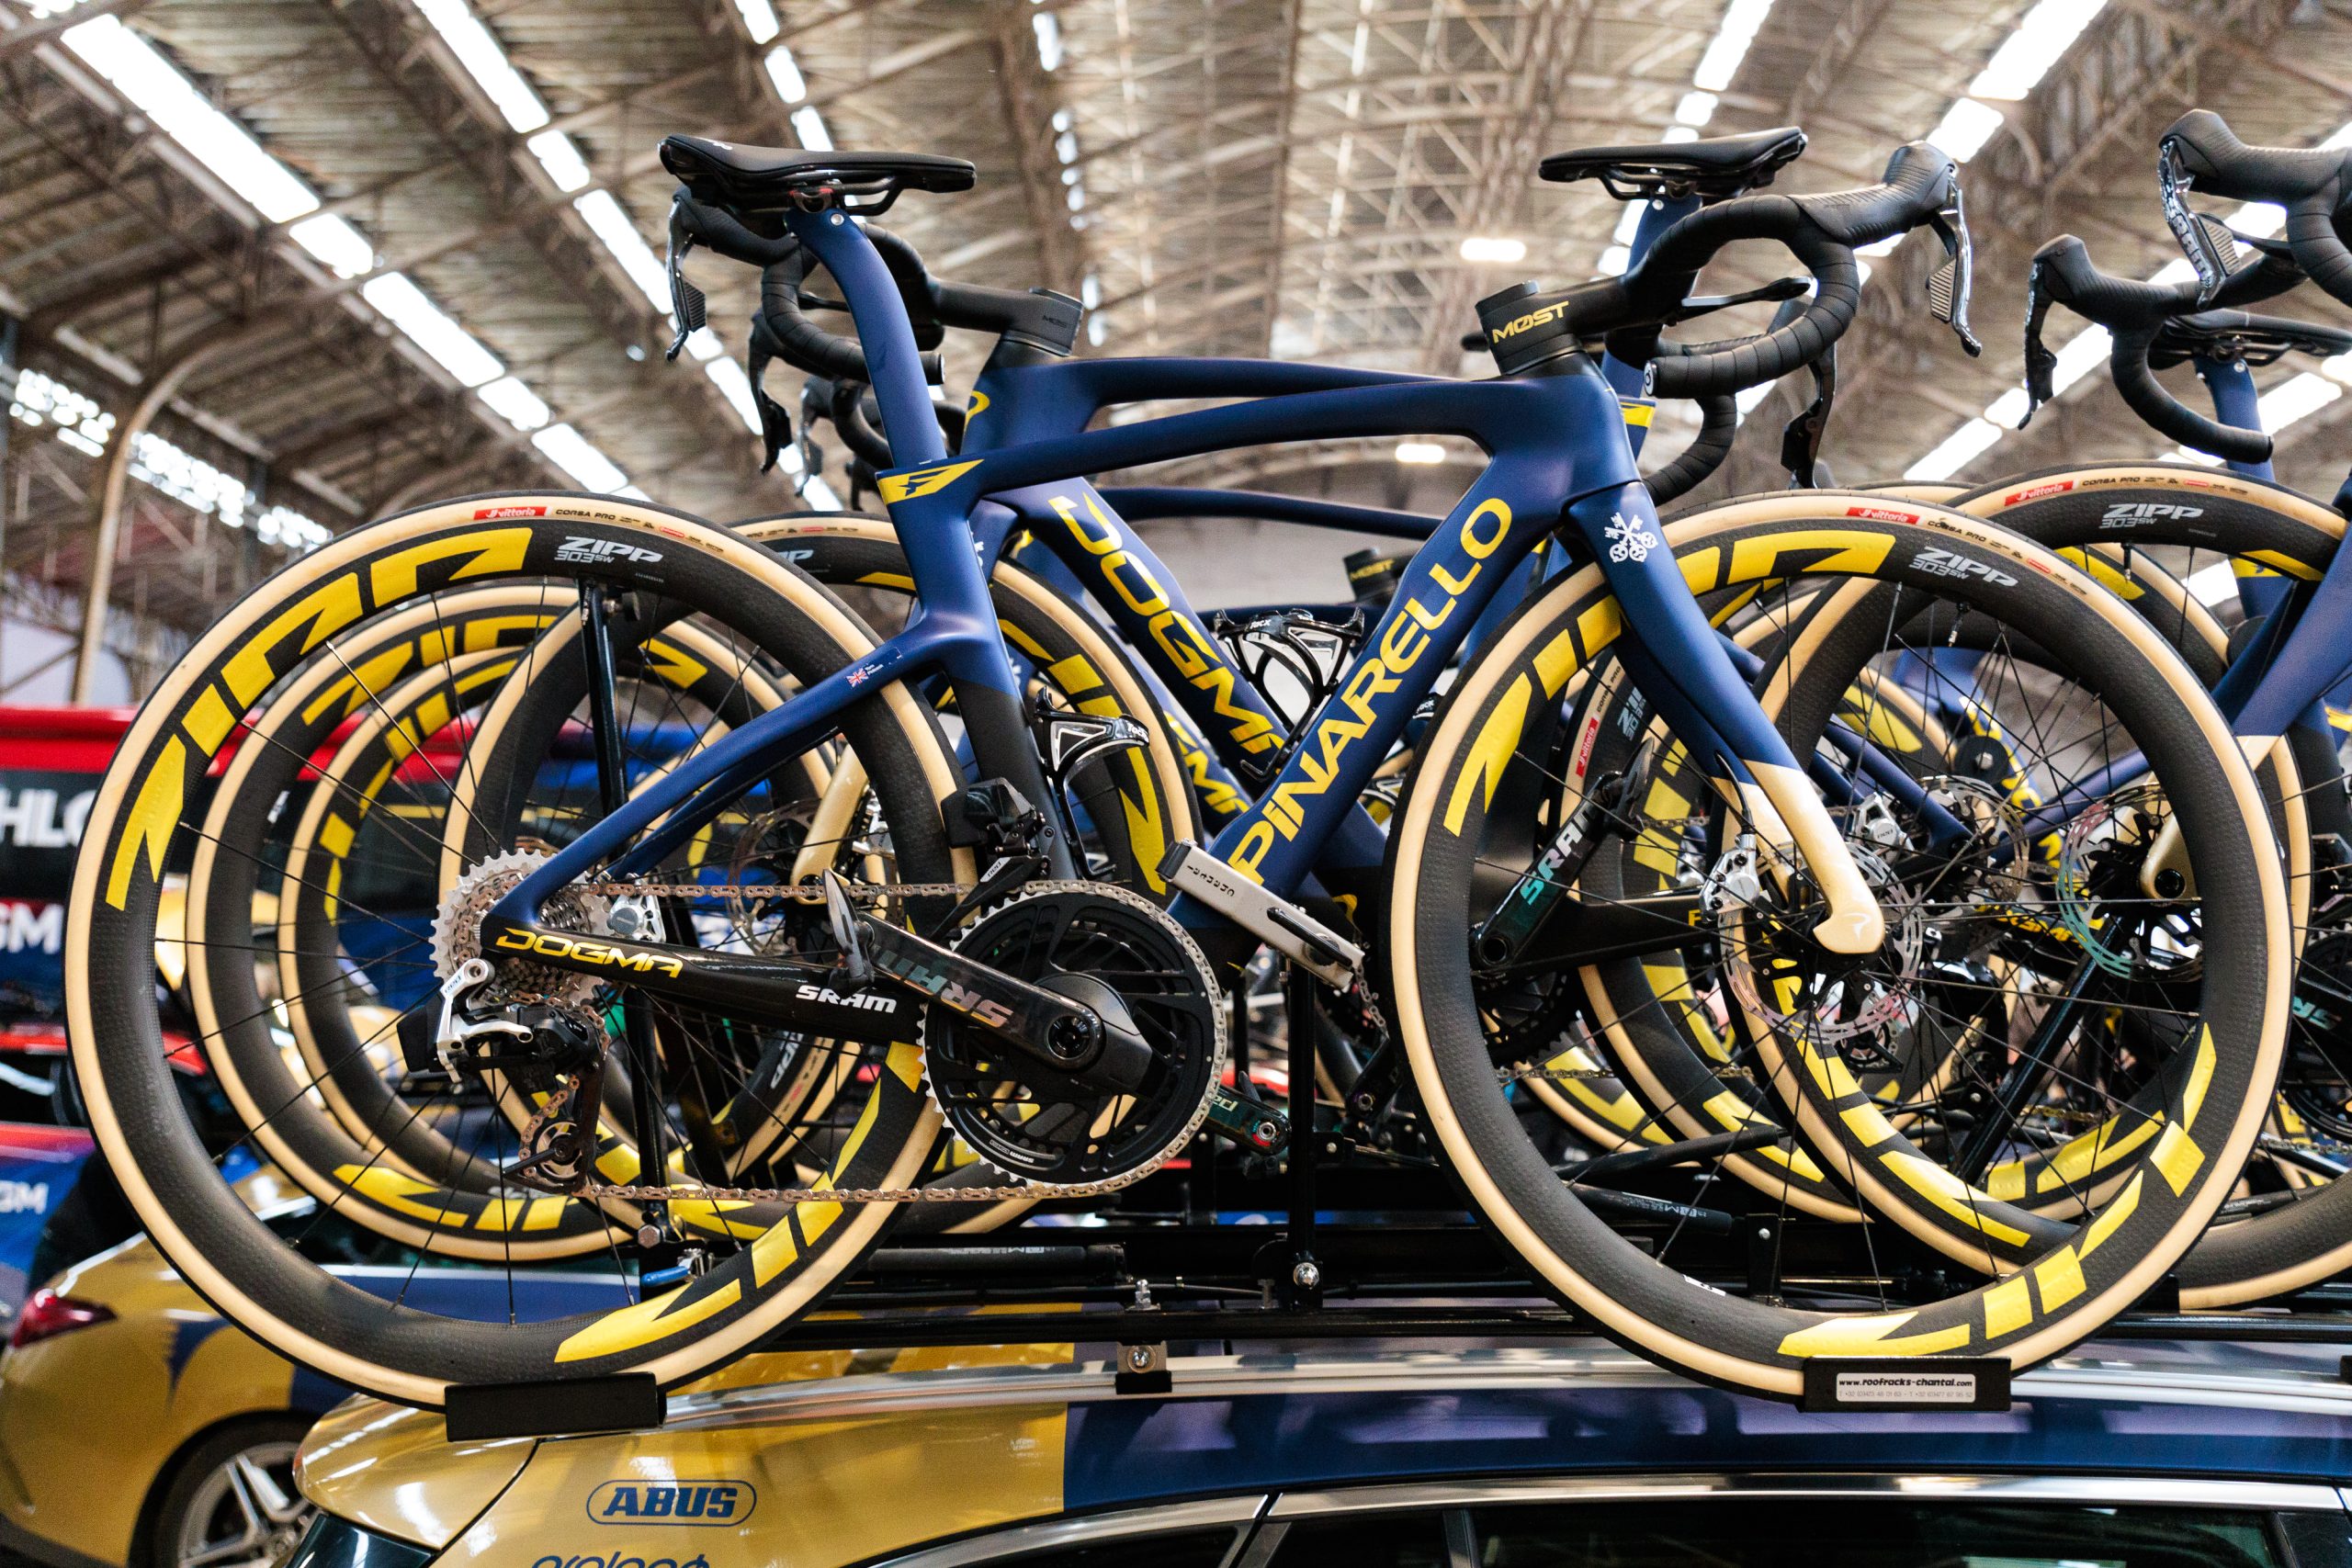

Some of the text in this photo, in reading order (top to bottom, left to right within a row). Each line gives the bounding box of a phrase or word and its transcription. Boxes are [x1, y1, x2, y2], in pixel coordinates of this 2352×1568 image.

[2082, 477, 2116, 486] CORSA
[2027, 484, 2064, 498] vittoria
[497, 506, 536, 518] vittoria
[555, 508, 616, 521] CORSA PRO
[1871, 509, 1908, 523] vittoria
[2102, 502, 2204, 520] ZIPP
[1965, 531, 1986, 543] PRO
[558, 536, 663, 563] ZIPP
[1916, 546, 2019, 587] ZIPP
[1227, 497, 1513, 887] PINARELLO
[1581, 725, 1597, 760] vittoria
[495, 927, 683, 978] DOGMA
[796, 985, 897, 1014] SRAM
[1838, 1377, 1973, 1387] www.roofracks-chantal.com
[603, 1486, 738, 1518] ABUS
